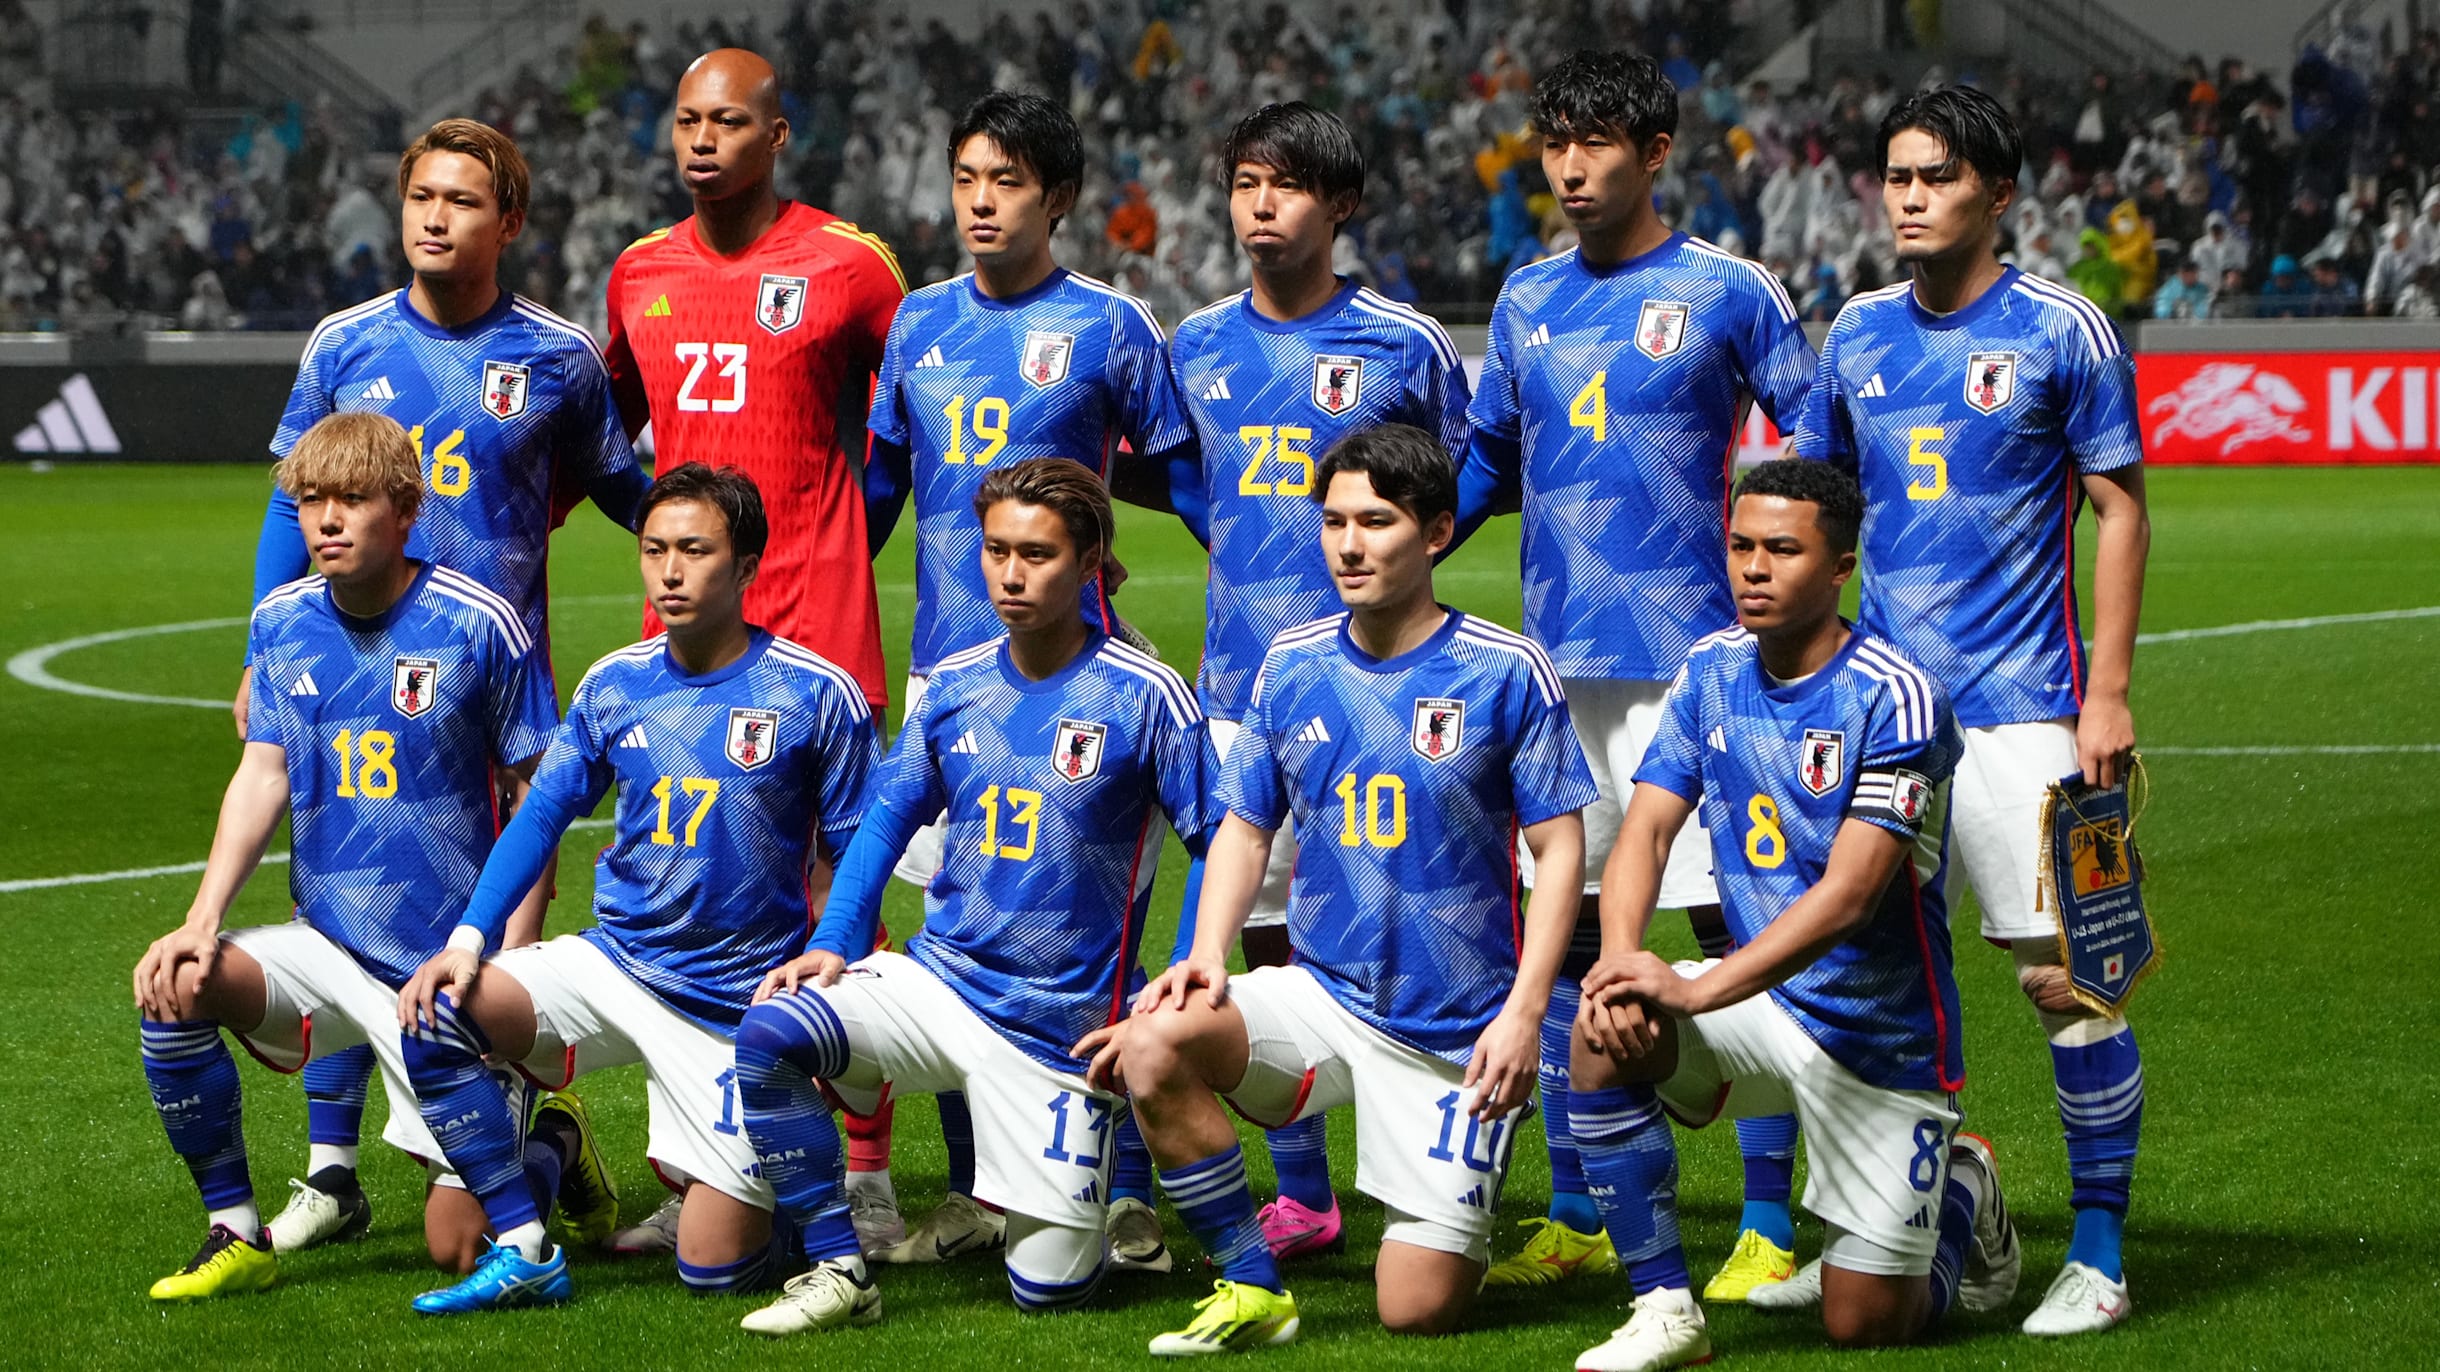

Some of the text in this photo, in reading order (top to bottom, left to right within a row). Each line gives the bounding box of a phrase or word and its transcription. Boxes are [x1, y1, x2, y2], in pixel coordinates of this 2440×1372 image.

[495, 364, 520, 373] JAPAN
[676, 343, 748, 411] 23
[945, 397, 1010, 466] 19
[1571, 372, 1606, 441] 4
[2328, 366, 2440, 450] KI
[1240, 426, 1316, 496] 25
[1907, 429, 1947, 500] 5
[1069, 723, 1093, 732] JAPAN
[333, 730, 398, 799] 18
[650, 776, 720, 847] 17
[979, 786, 1042, 860] 13
[1337, 775, 1407, 848] 10
[1746, 793, 1786, 868] 8
[1043, 1091, 1112, 1170] 13
[1428, 1090, 1507, 1173] 10
[1909, 1118, 1943, 1192] 8
